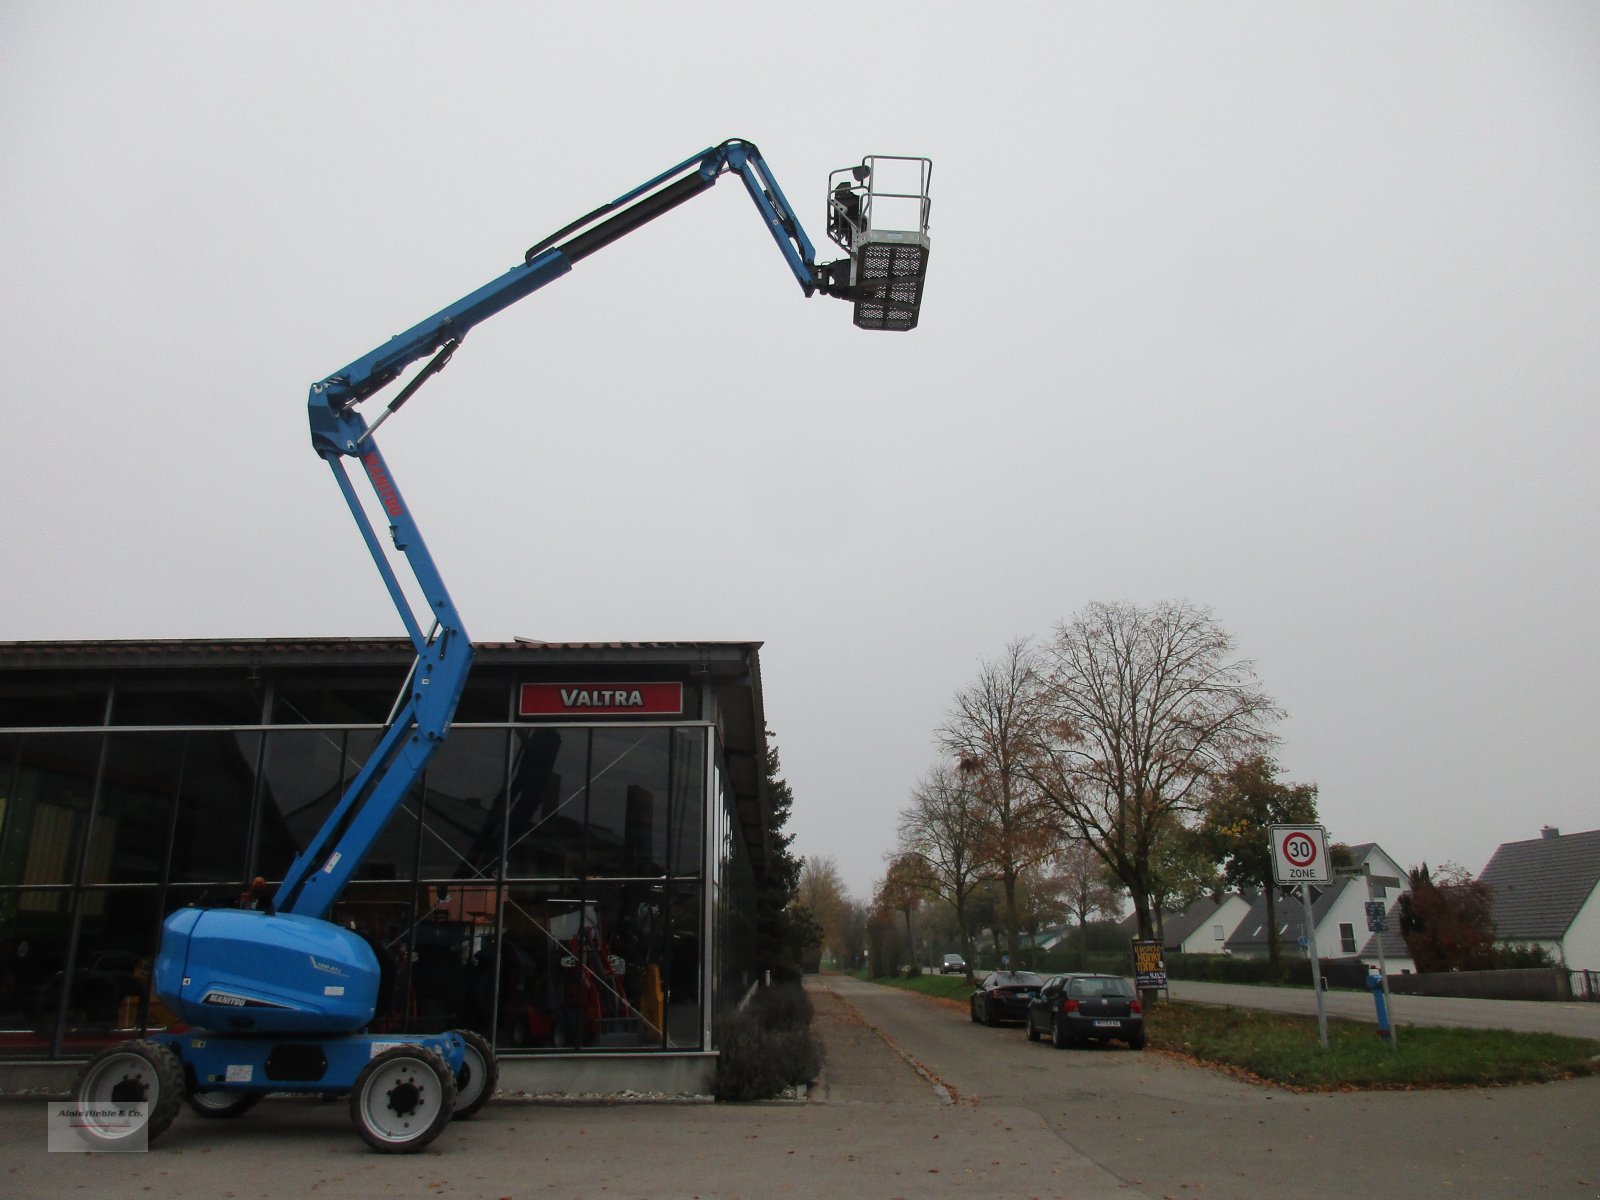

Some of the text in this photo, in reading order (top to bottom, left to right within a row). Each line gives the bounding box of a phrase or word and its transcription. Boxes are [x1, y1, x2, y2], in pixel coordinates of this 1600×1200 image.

[560, 688, 643, 707] VALTRA
[1289, 841, 1310, 858] 30
[1290, 869, 1316, 879] ZONE
[208, 994, 247, 1007] MANITOU
